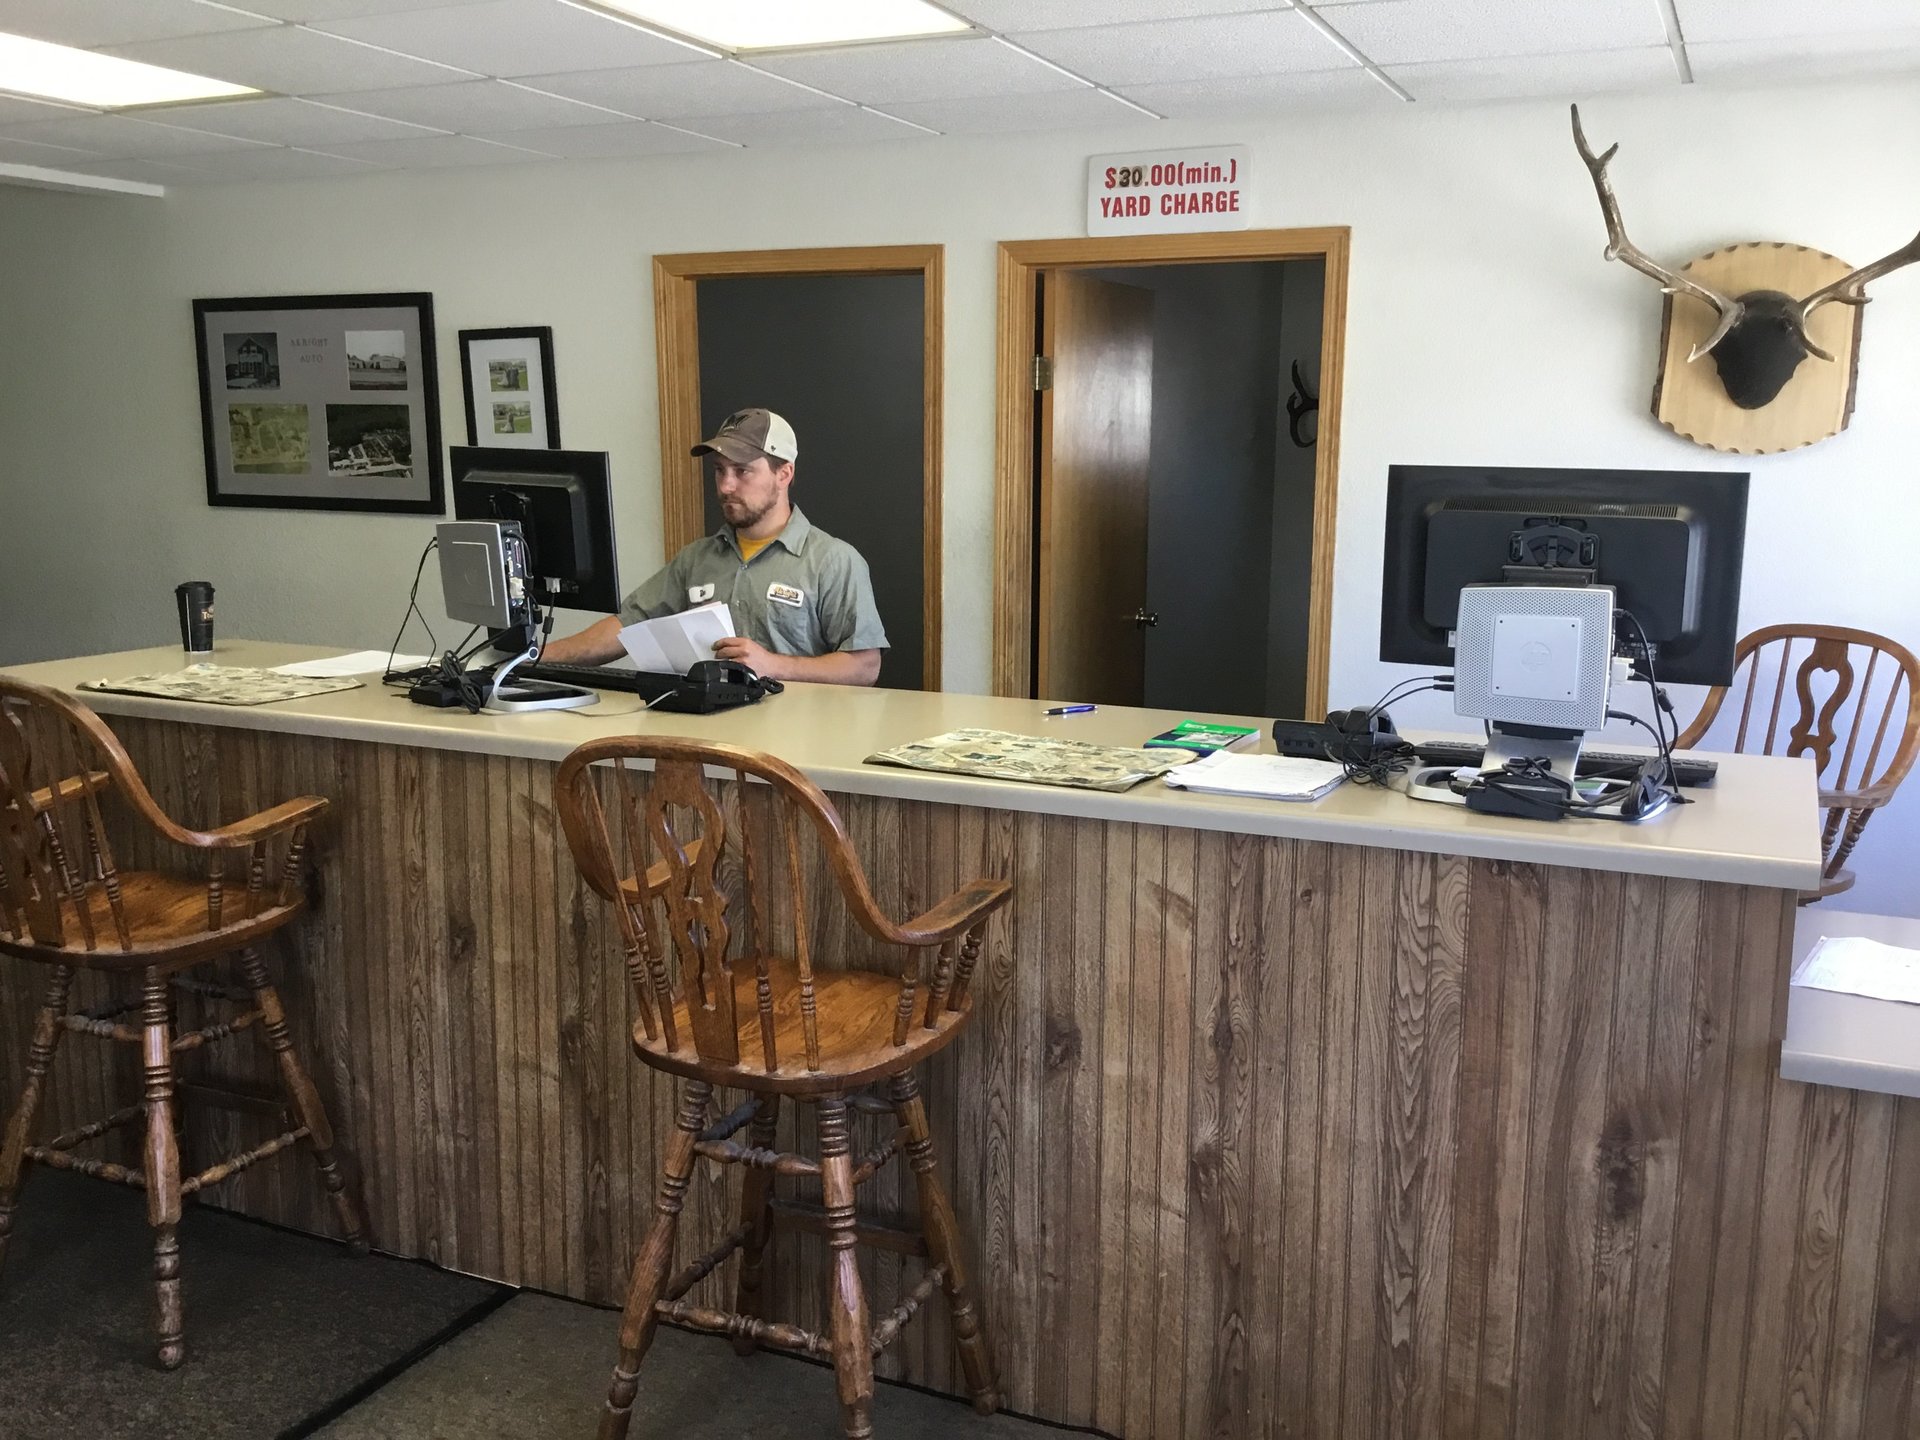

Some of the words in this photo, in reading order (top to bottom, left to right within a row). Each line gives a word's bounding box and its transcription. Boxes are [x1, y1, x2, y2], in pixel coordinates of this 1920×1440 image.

[1104, 158, 1236, 190] $30.00(min.)
[1100, 195, 1151, 218] YARD
[1160, 190, 1240, 215] CHARGE
[300, 353, 323, 363] AUTO
